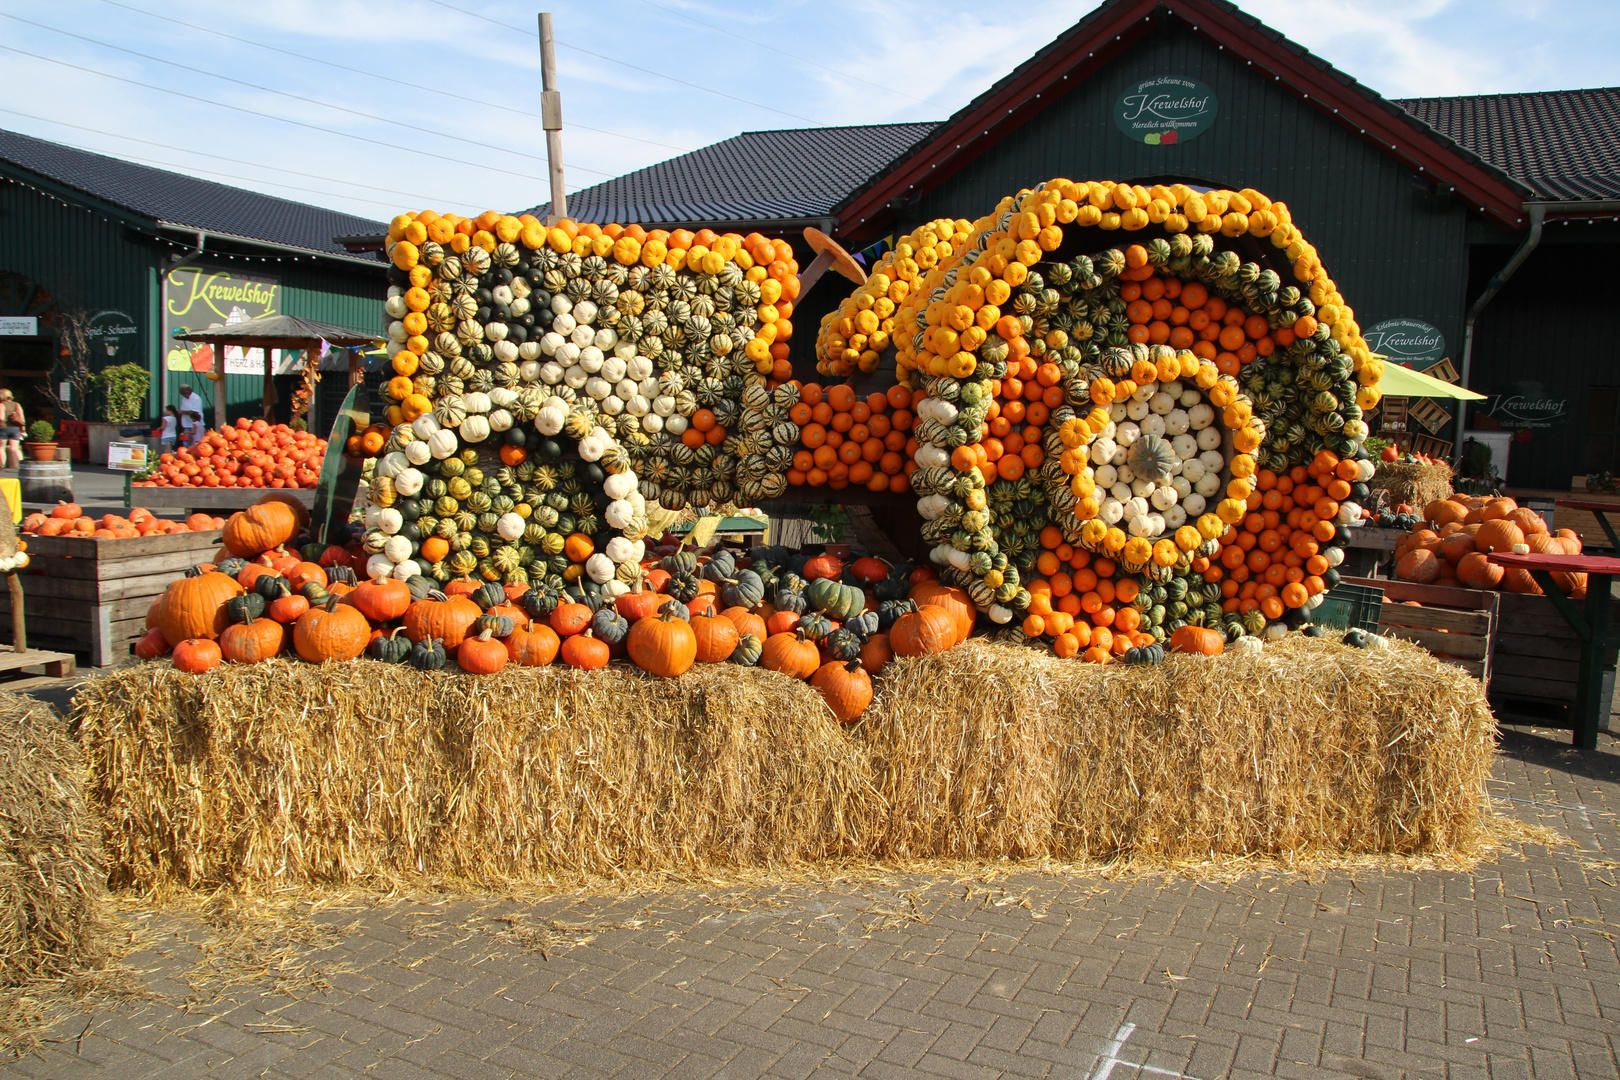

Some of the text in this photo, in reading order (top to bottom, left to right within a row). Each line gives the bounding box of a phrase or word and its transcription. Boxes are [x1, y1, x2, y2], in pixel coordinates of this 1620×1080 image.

[1138, 76, 1195, 93] grüne Scheune vom
[1123, 94, 1210, 120] Krewelshof
[1132, 120, 1197, 129] Herzlich willkommen
[167, 266, 277, 319] Krewelshof
[84, 324, 103, 340] Spiel
[107, 323, 137, 335] Scheune
[1362, 331, 1441, 355] Krewelshof
[230, 358, 248, 367] HERZ
[250, 359, 255, 367] &
[1476, 394, 1566, 420] Krewelshof
